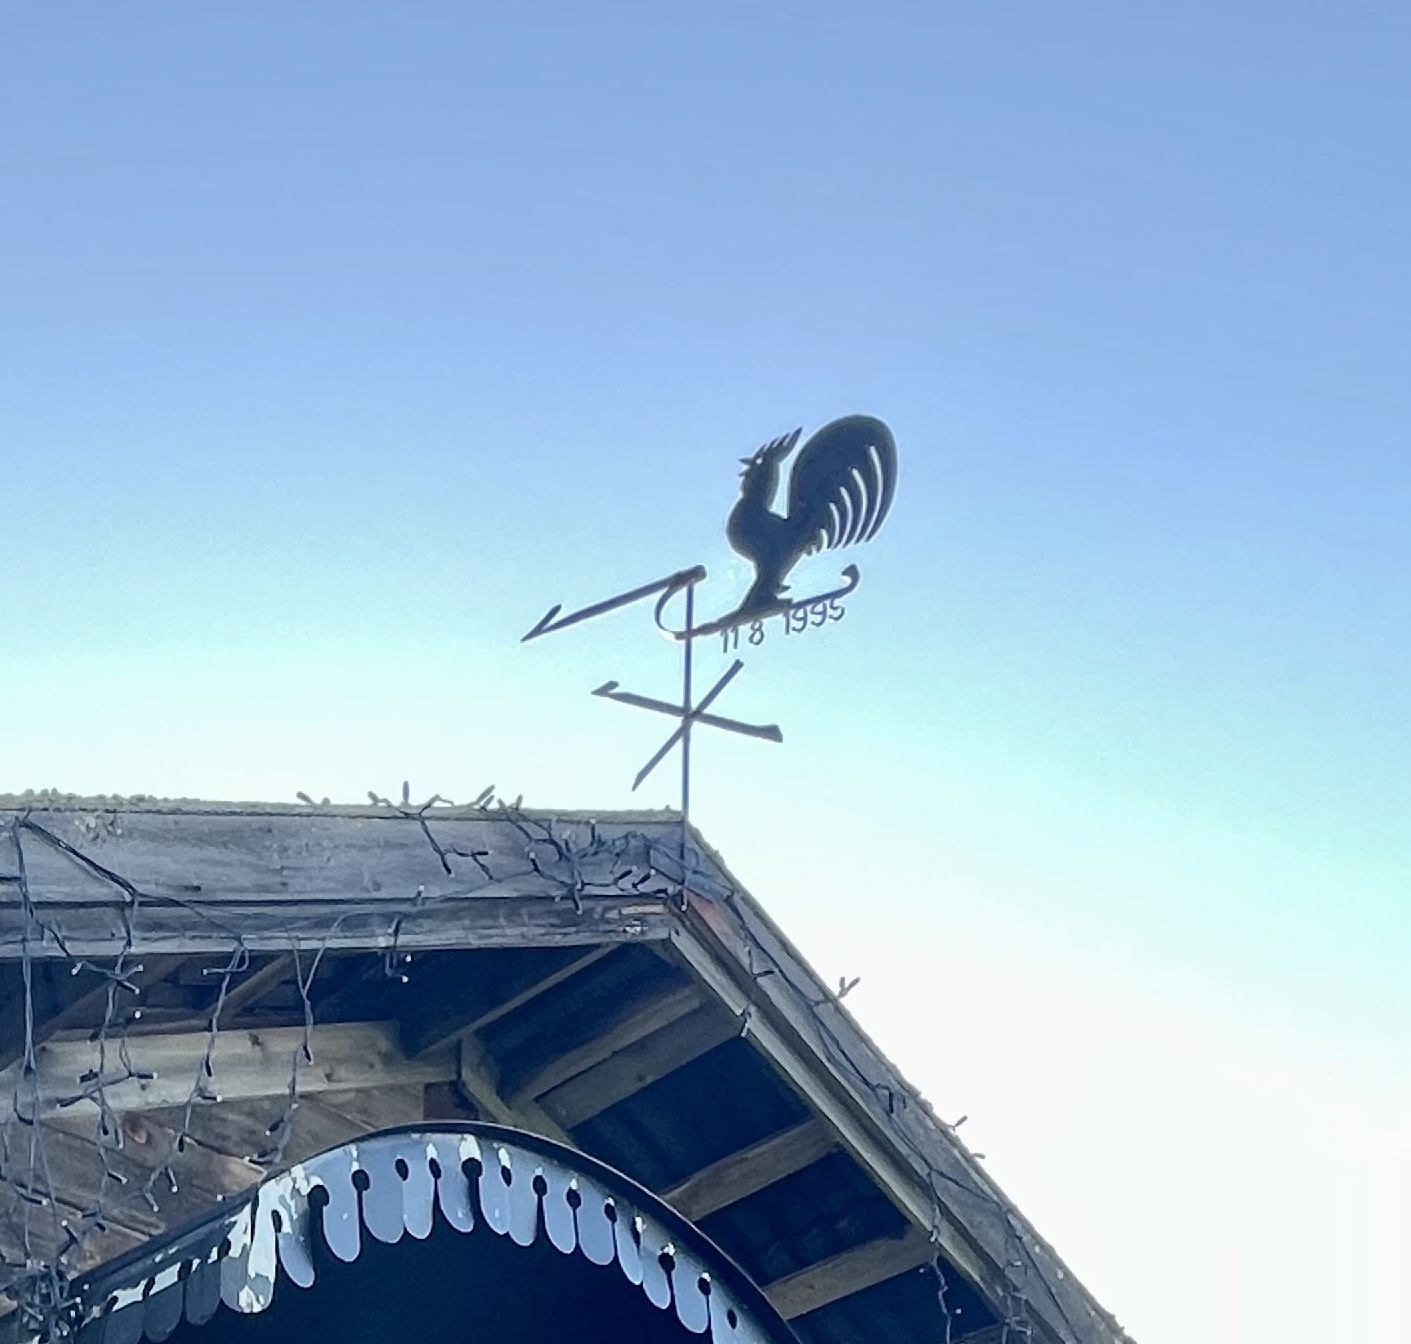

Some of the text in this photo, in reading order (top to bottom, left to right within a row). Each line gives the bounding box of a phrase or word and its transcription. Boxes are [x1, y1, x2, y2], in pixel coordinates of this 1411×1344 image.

[720, 599, 845, 653] 11 8 1995
